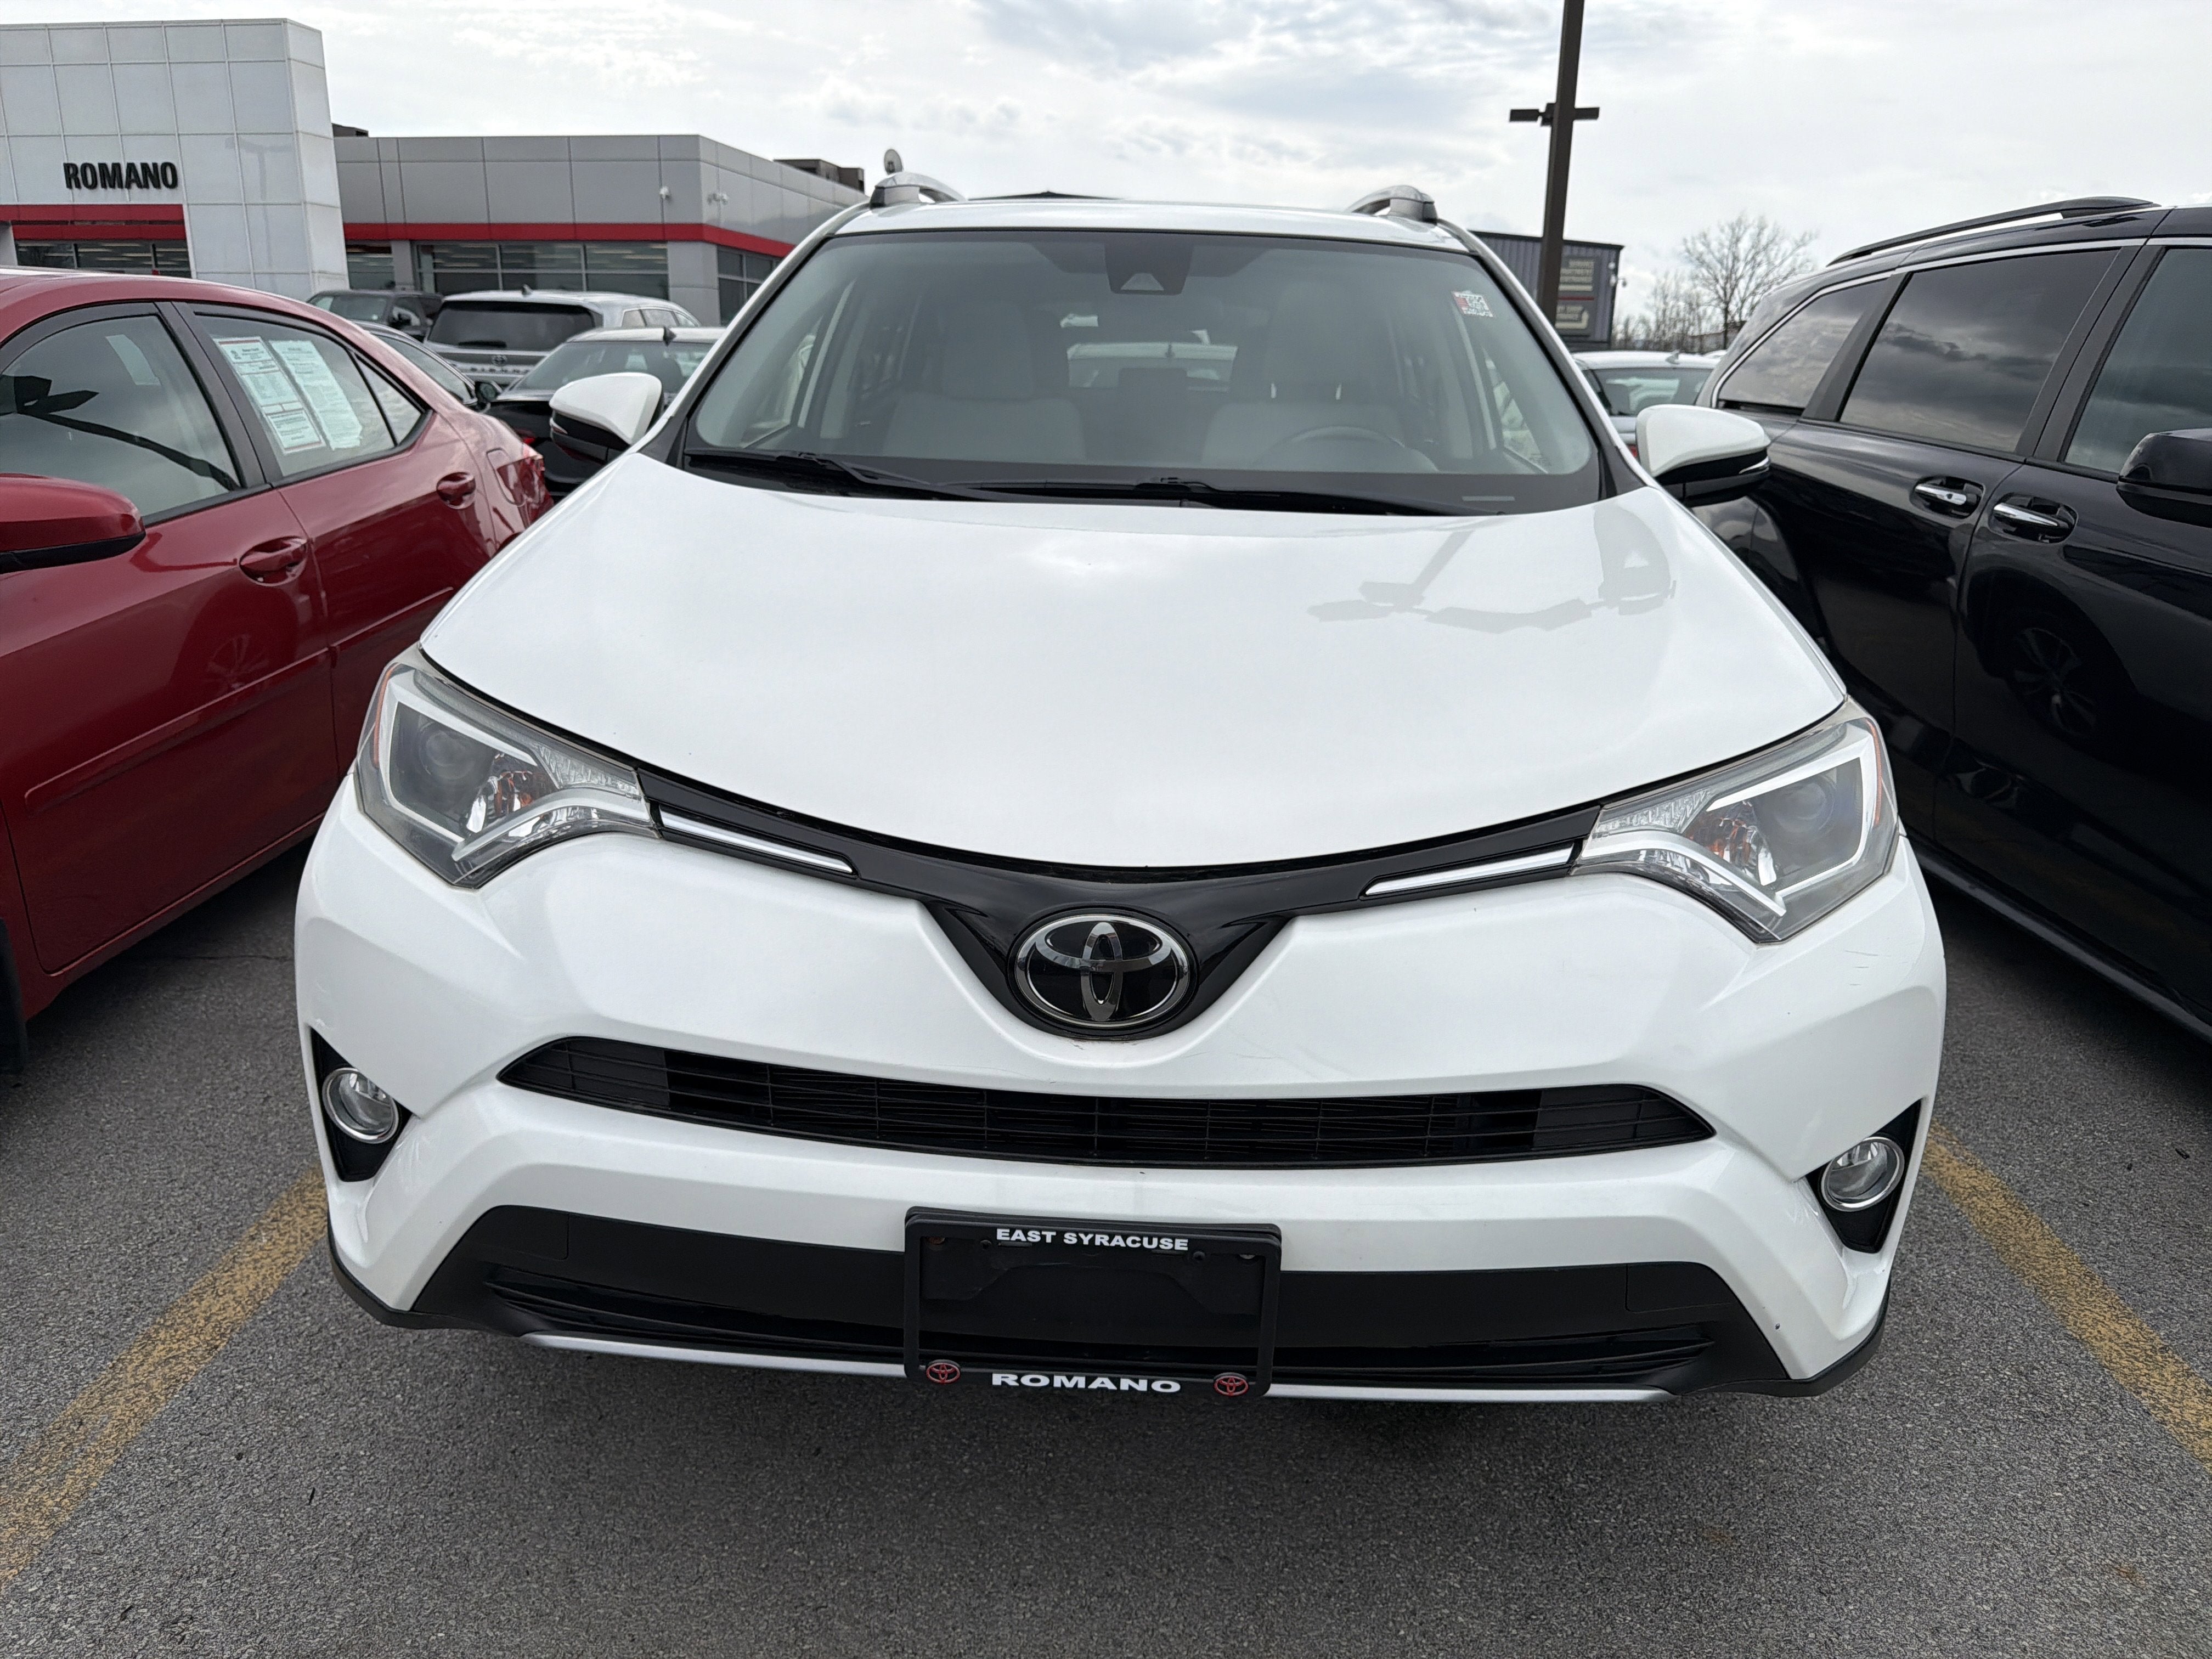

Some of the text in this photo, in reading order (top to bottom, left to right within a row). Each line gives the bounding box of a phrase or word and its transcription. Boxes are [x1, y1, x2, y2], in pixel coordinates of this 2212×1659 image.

[63, 161, 178, 190] ROMANO
[996, 1228, 1189, 1251] EAST SYRACUSE
[992, 1373, 1181, 1393] ROMANO
